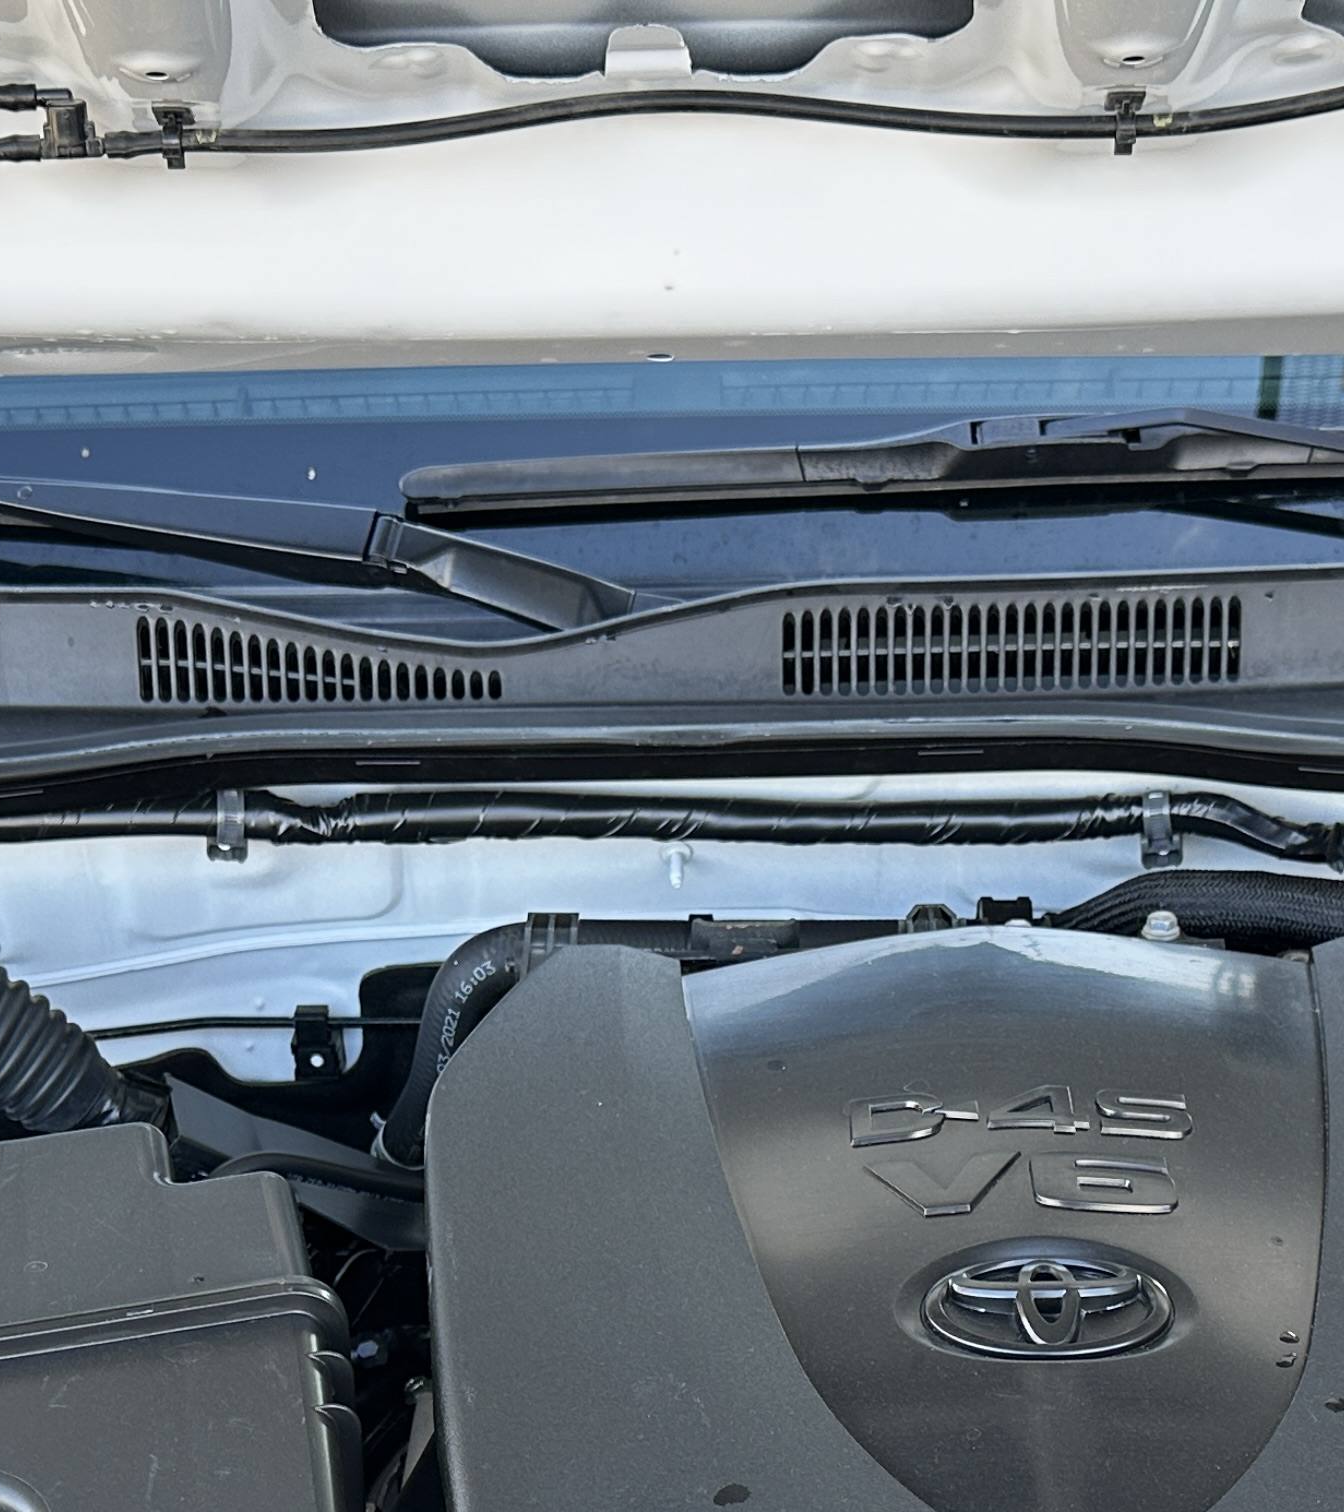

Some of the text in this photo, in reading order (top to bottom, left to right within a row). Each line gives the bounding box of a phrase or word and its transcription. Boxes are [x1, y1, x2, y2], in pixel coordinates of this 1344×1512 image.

[455, 960, 497, 1003] 16:03
[848, 1084, 1194, 1149] D-4S
[864, 1151, 1179, 1217] V6
